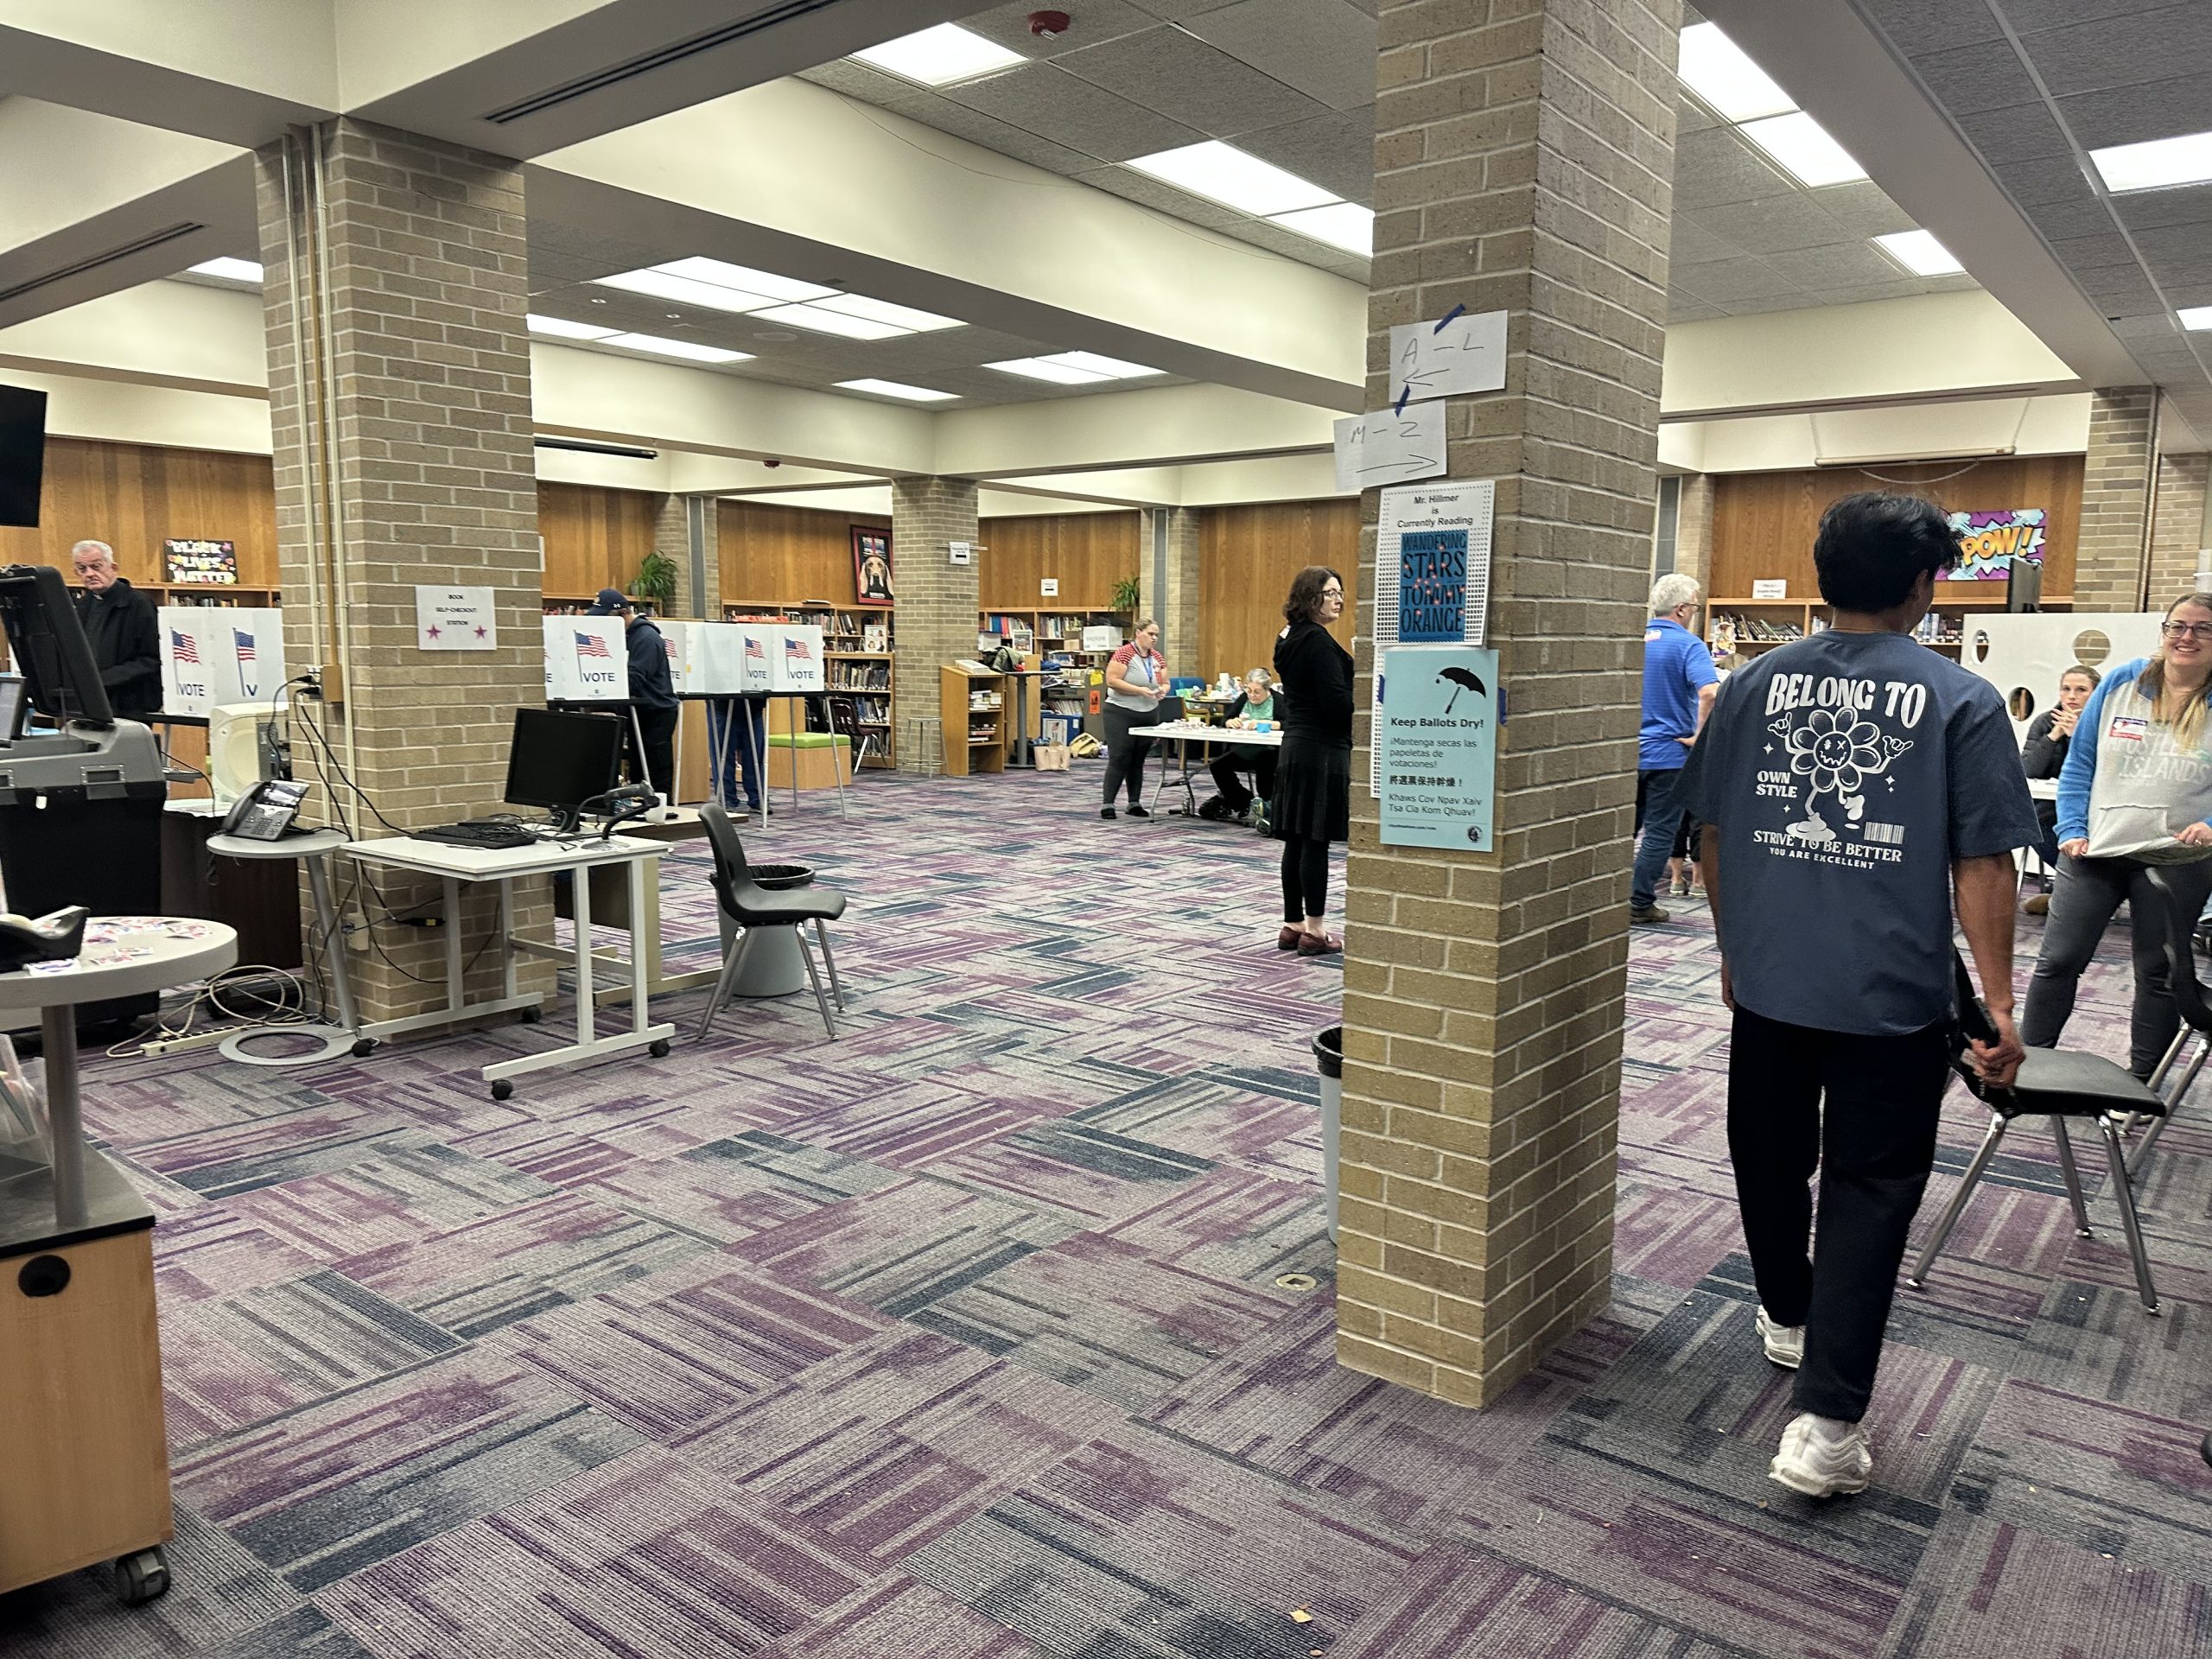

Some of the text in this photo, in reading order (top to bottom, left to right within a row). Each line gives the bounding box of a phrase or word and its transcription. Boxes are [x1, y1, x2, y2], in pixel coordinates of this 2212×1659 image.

[1428, 494, 1459, 503] Hillmer
[1397, 517, 1473, 528] Currently Reading
[1402, 532, 1467, 550] WANDERING
[1960, 526, 2034, 567] POW!
[1402, 550, 1465, 579] STARS
[1402, 584, 1466, 607] TOMMY
[1401, 607, 1464, 632] ORANGE
[583, 672, 615, 683] VOTE
[670, 671, 681, 680] TE
[748, 670, 767, 679] VOTE
[790, 671, 815, 679] VOTE
[178, 683, 206, 696] VOTE
[1764, 673, 1927, 729] BELONG TO
[1390, 717, 1484, 729] Keep Ballots Dry!
[1389, 737, 1434, 748] ¡Mantenga
[1464, 739, 1478, 747] las
[1389, 749, 1431, 758] papeletas
[1389, 760, 1437, 769] votaciones!
[1757, 770, 1791, 785] OWN
[1755, 784, 1798, 798] STYLE
[1389, 793, 1483, 806] Khaws Cov Npav Xaiv
[1389, 804, 1403, 812] Tsa
[1421, 805, 1442, 815] Kom
[1443, 806, 1476, 817] Qhuav!
[1753, 830, 1903, 862] STRIVE TO BE BETTER
[1770, 847, 1875, 870] YOU ARE EXCELLENT
